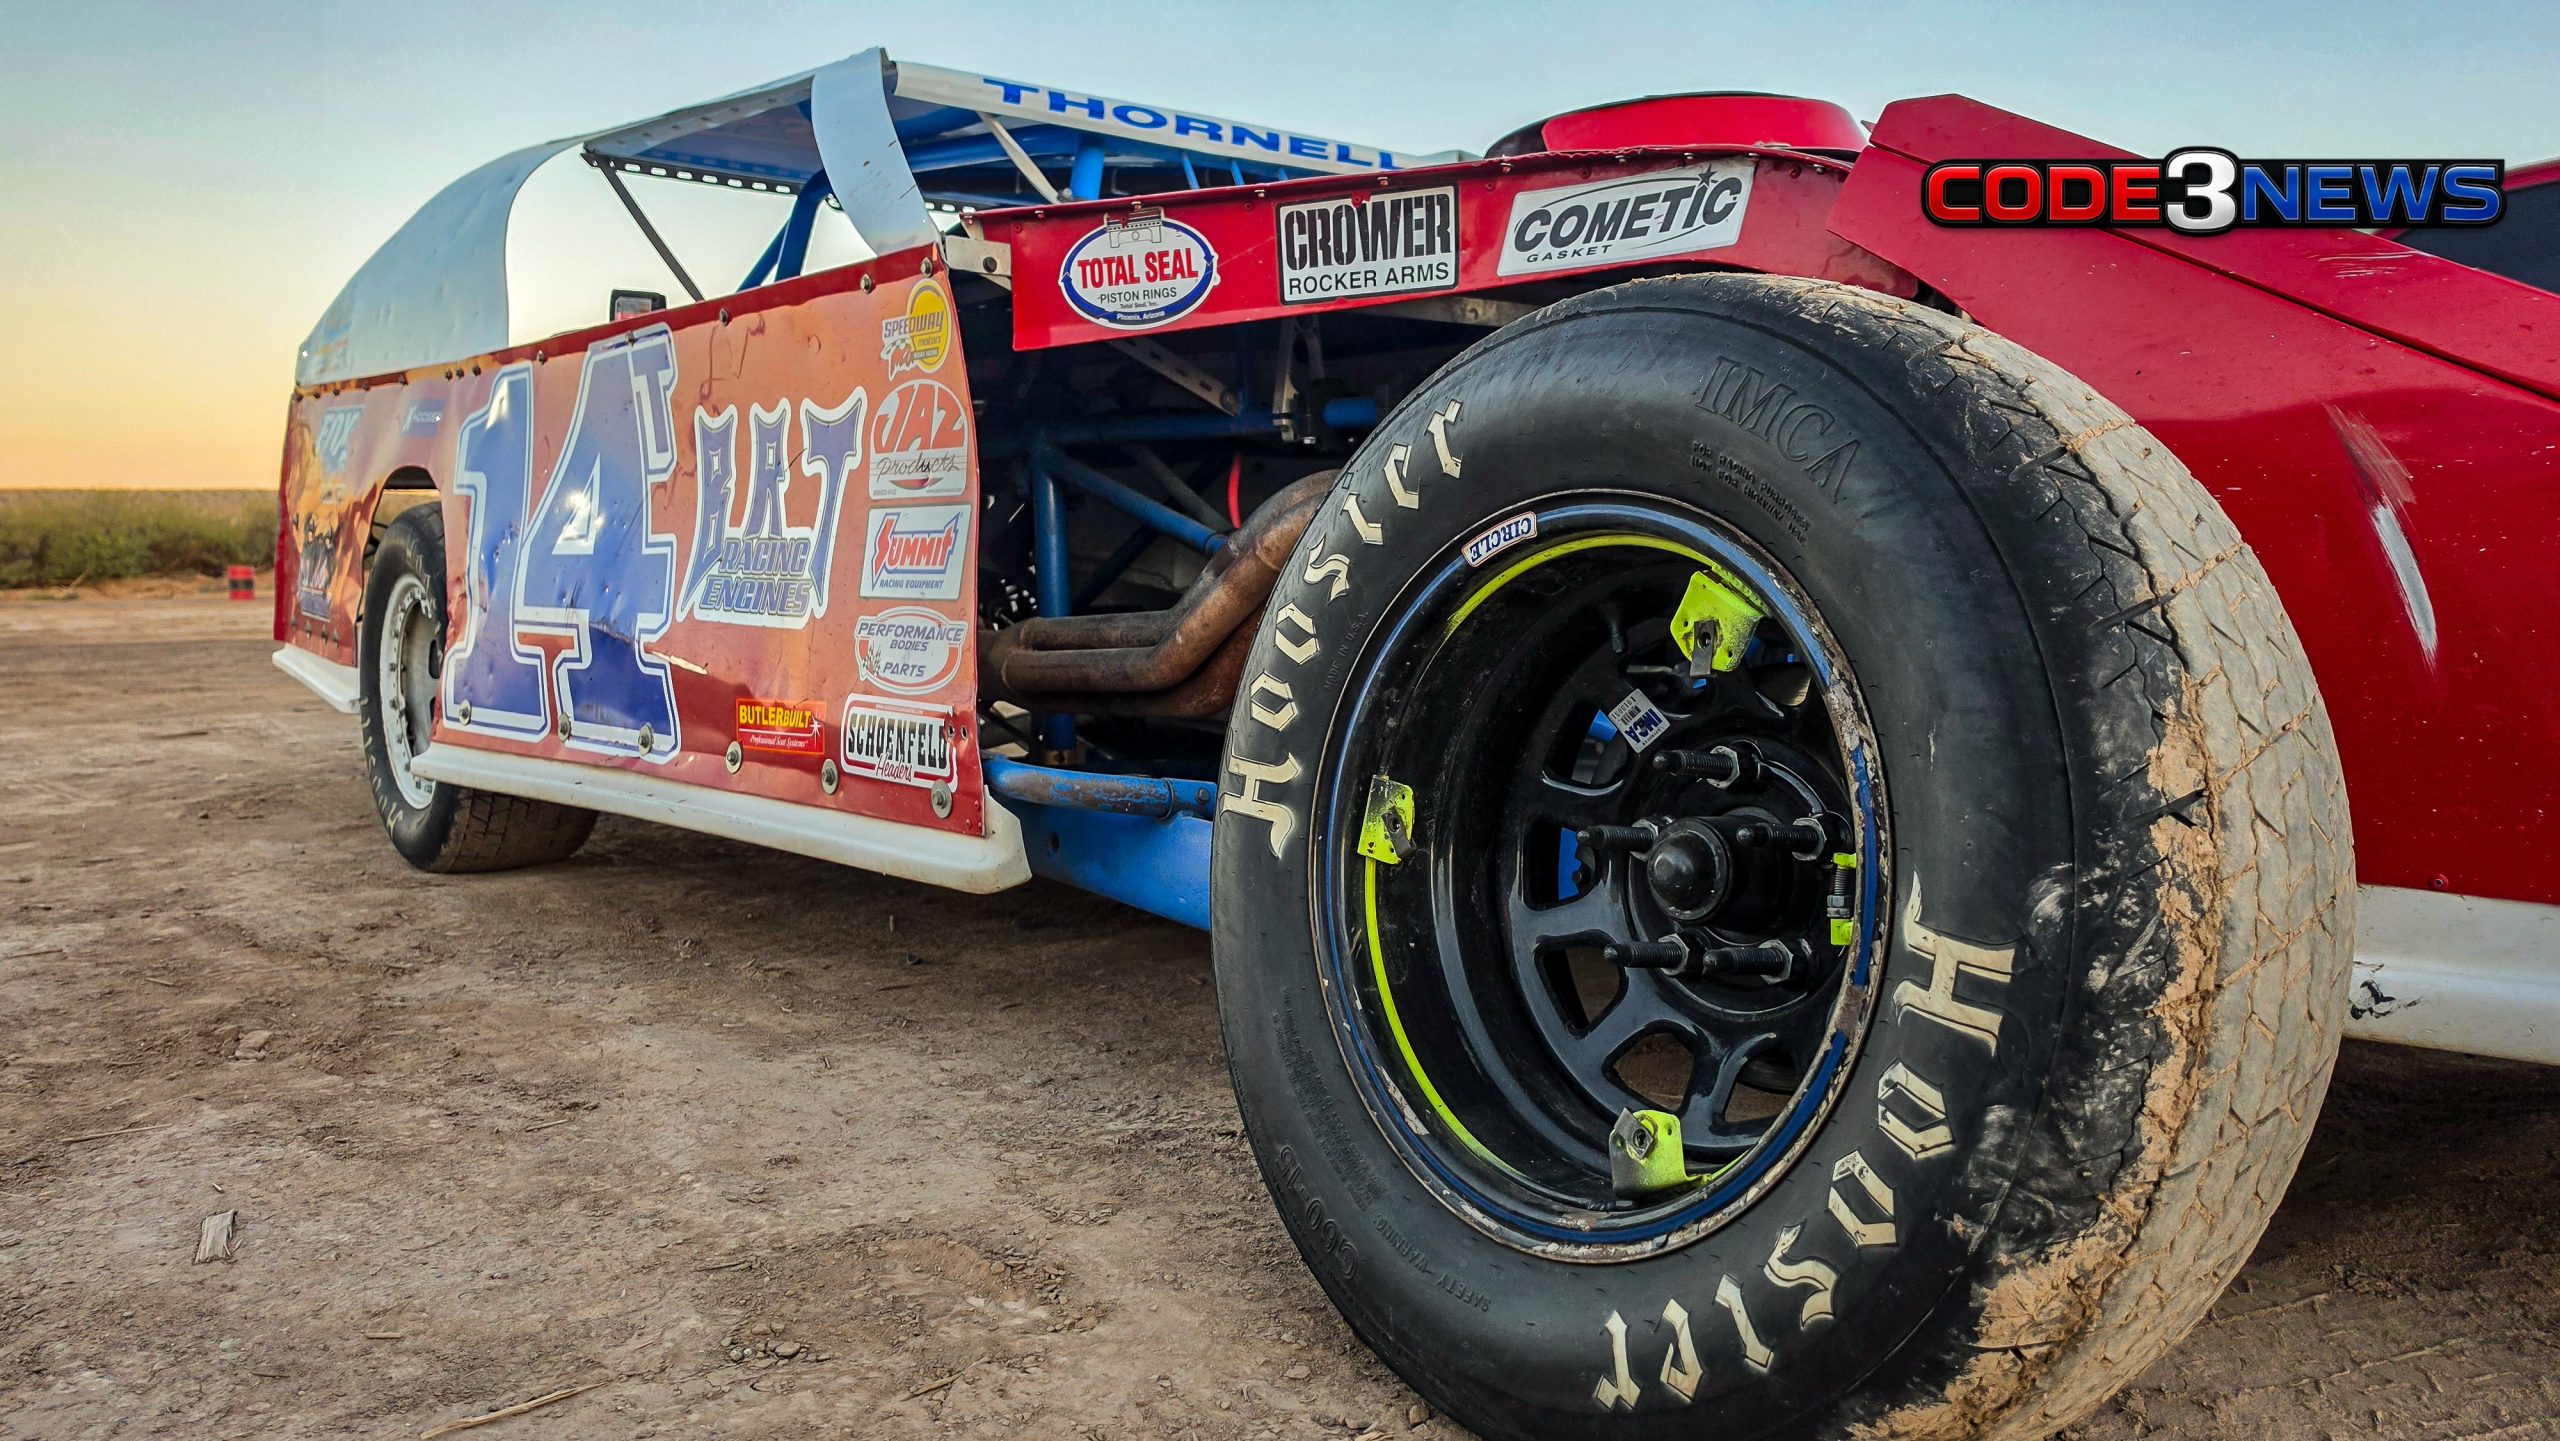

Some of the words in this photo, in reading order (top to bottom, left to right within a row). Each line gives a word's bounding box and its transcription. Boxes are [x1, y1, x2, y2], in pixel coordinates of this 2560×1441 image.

[983, 78, 1406, 170] THORNELL
[1285, 193, 1452, 270] CROWER
[1514, 174, 1742, 253] COMETIC
[1077, 254, 1140, 289] TOTAL
[1144, 248, 1198, 283] SEAL
[1526, 244, 1613, 263] GASKET
[1100, 290, 1139, 304] PISTON
[1143, 287, 1177, 299] RINGS
[1289, 270, 1377, 295] ROCKER
[1385, 262, 1449, 286] ARMS
[884, 310, 944, 338] SPEEDWAY
[873, 383, 965, 454] JAZ
[1695, 355, 1863, 504] IMCA
[719, 539, 811, 575] RACING
[1469, 517, 1532, 563] CIRCLE
[699, 576, 812, 616] ENGINES
[879, 579, 903, 588] RACING
[905, 580, 944, 589] EQUIPMENT
[857, 622, 964, 641] PERFORMANCE
[889, 639, 928, 651] BODIES
[882, 662, 926, 677] PARTS
[848, 712, 948, 769] SCHOENFELD
[1624, 708, 1663, 743] IMCA
[876, 753, 913, 782] Headers
[1436, 1273, 1492, 1313] SAFETY
